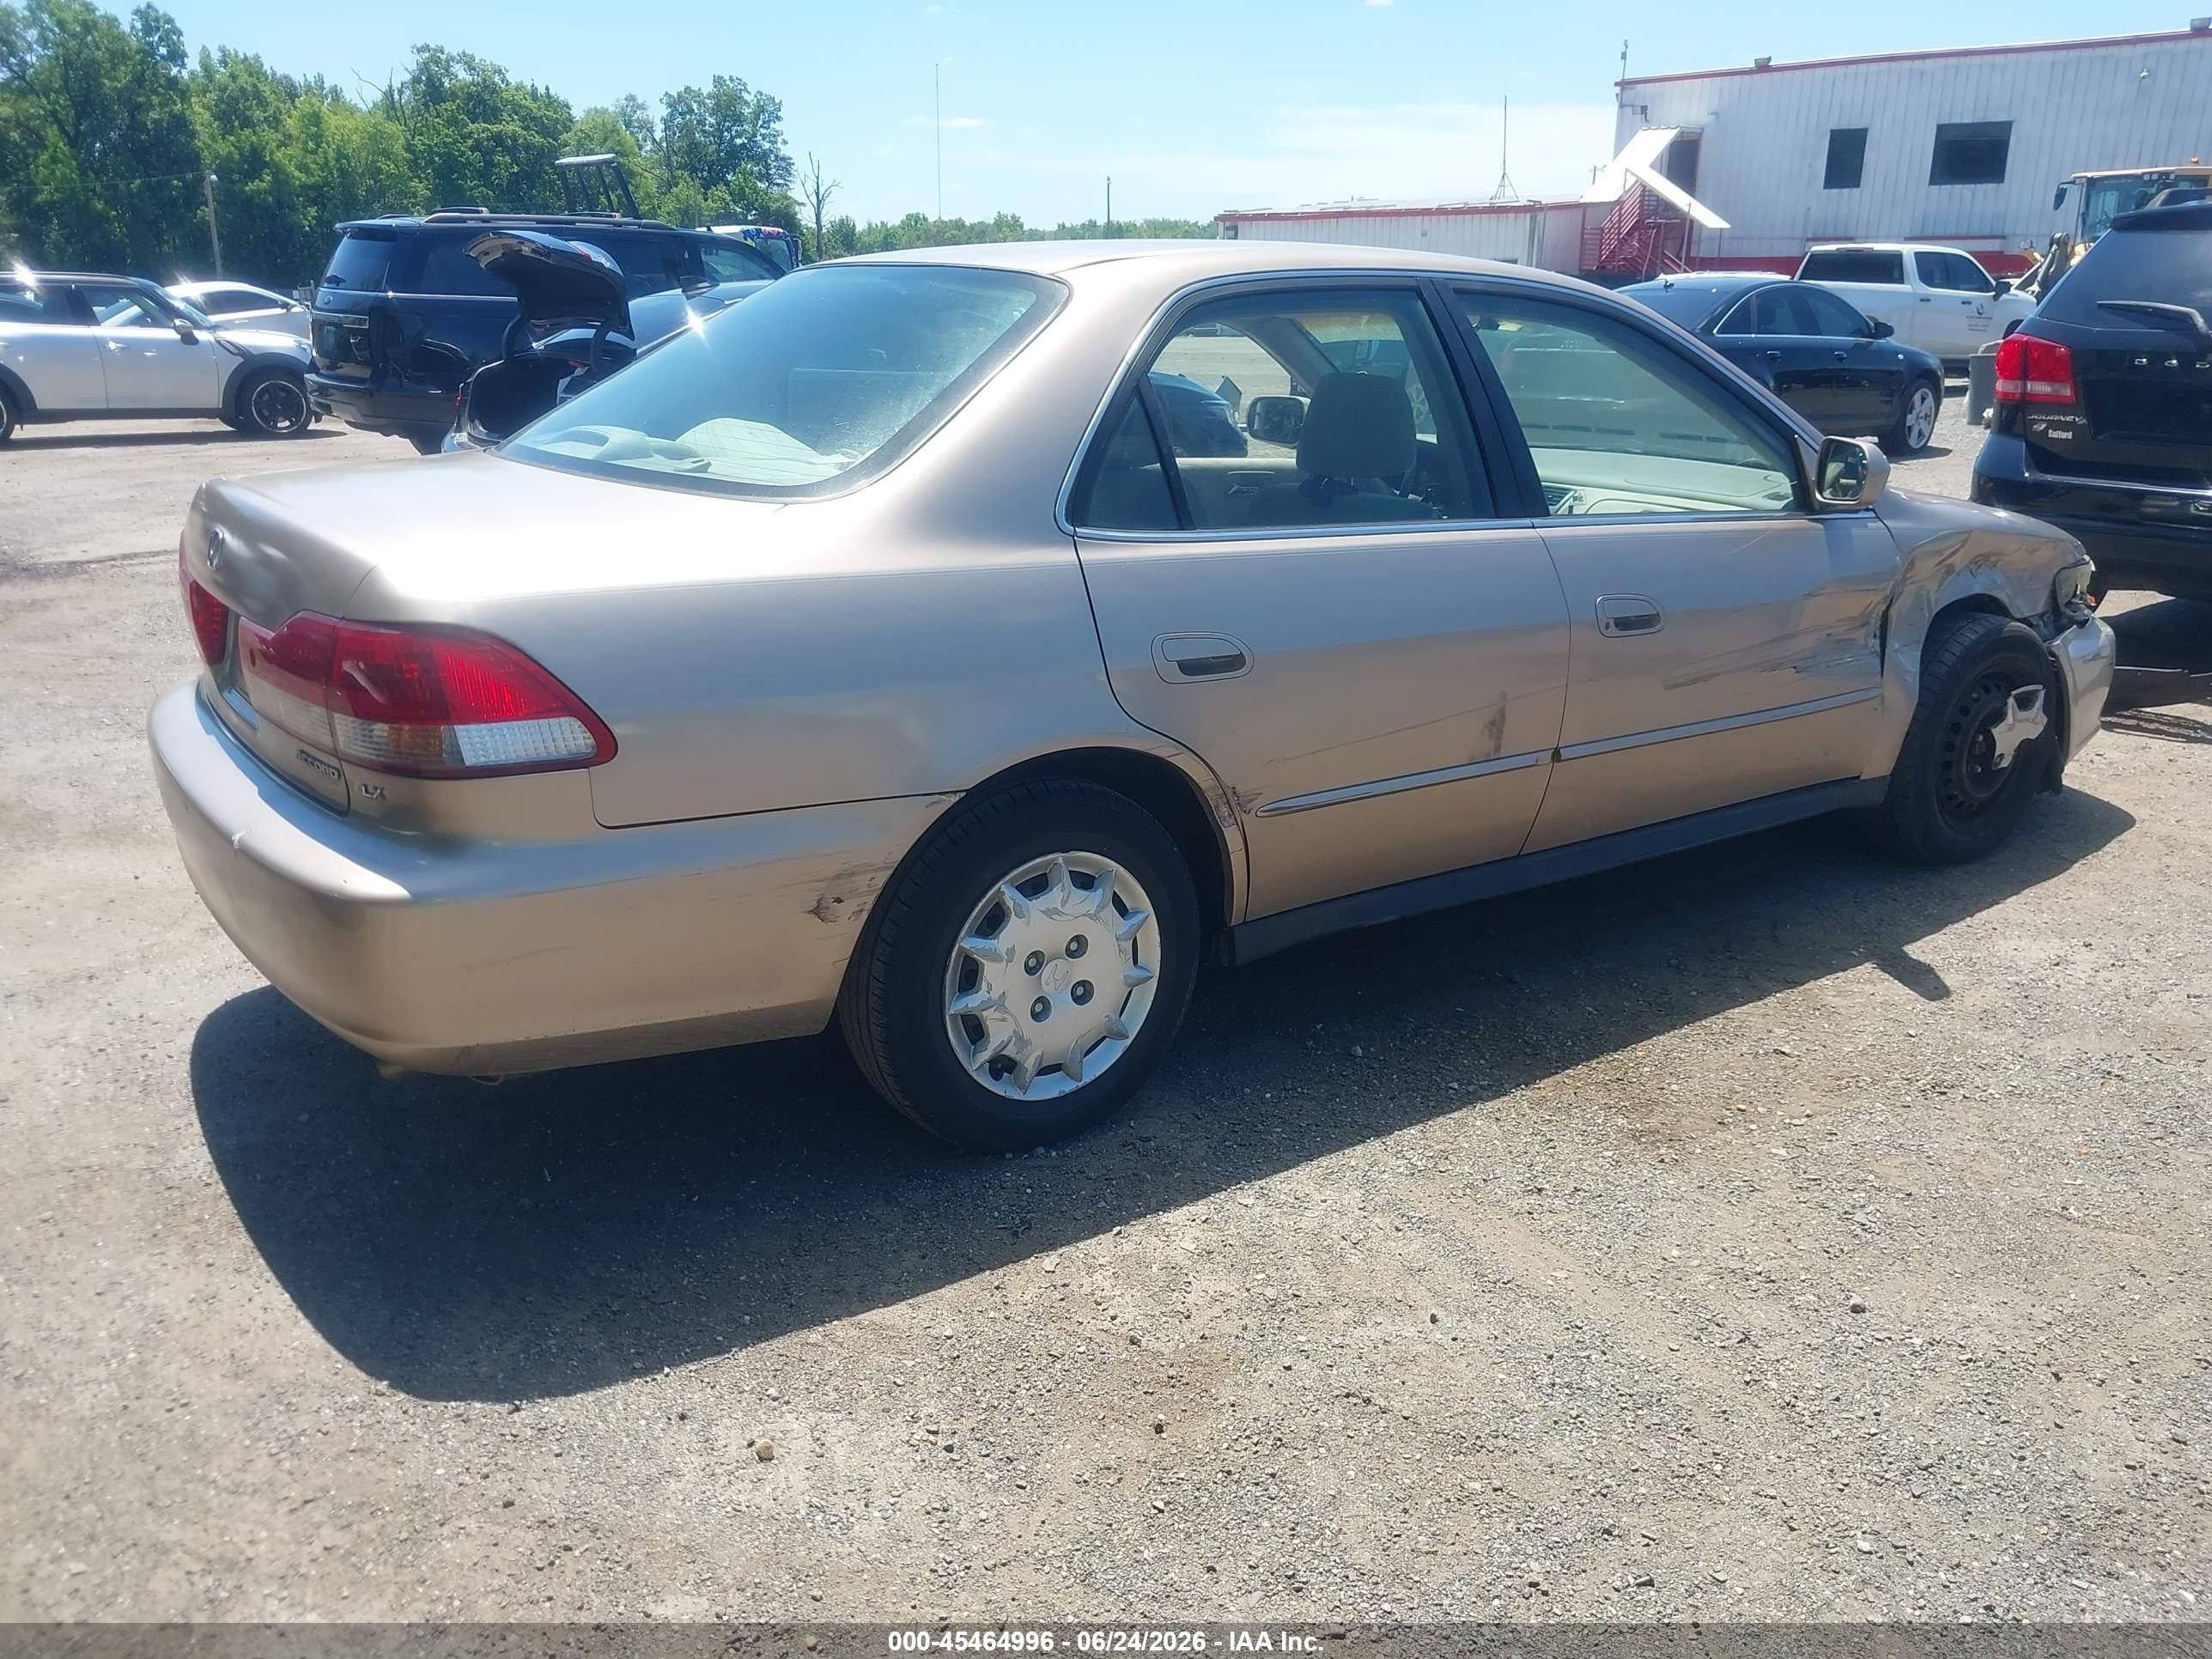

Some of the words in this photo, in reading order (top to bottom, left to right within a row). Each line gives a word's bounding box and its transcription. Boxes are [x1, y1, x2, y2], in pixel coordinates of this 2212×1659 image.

[2027, 414, 2084, 422] JOURNEY
[297, 750, 341, 781] ACCORD
[362, 783, 386, 799] LX
